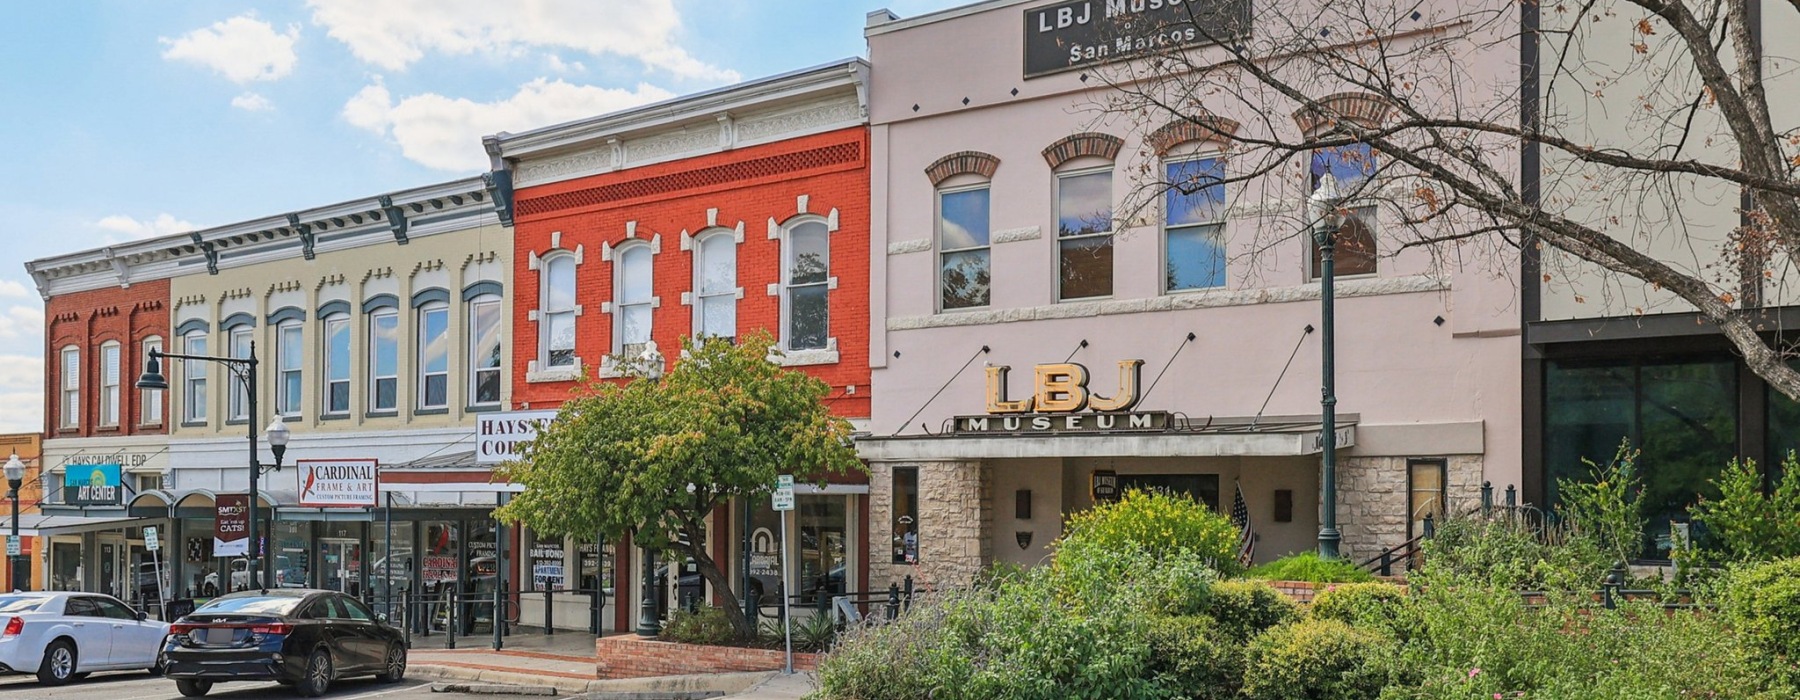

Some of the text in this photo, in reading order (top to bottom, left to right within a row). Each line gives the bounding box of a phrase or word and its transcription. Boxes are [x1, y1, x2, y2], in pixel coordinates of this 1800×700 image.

[1039, 2, 1091, 33] LBJ
[1069, 27, 1196, 62] San Marcos
[985, 358, 1146, 414] LBJ
[481, 419, 528, 436] HAYS
[968, 414, 1151, 431] MUSEUM
[72, 454, 147, 467] HAYS CALDWELL EDP
[315, 465, 373, 480] CARDINAL
[77, 485, 116, 501] ART CENTER
[316, 482, 373, 492] FRAME & ART
[220, 524, 245, 532] CATS!
[529, 549, 564, 559] BAIL BOND
[534, 566, 564, 576] APARTMENT
